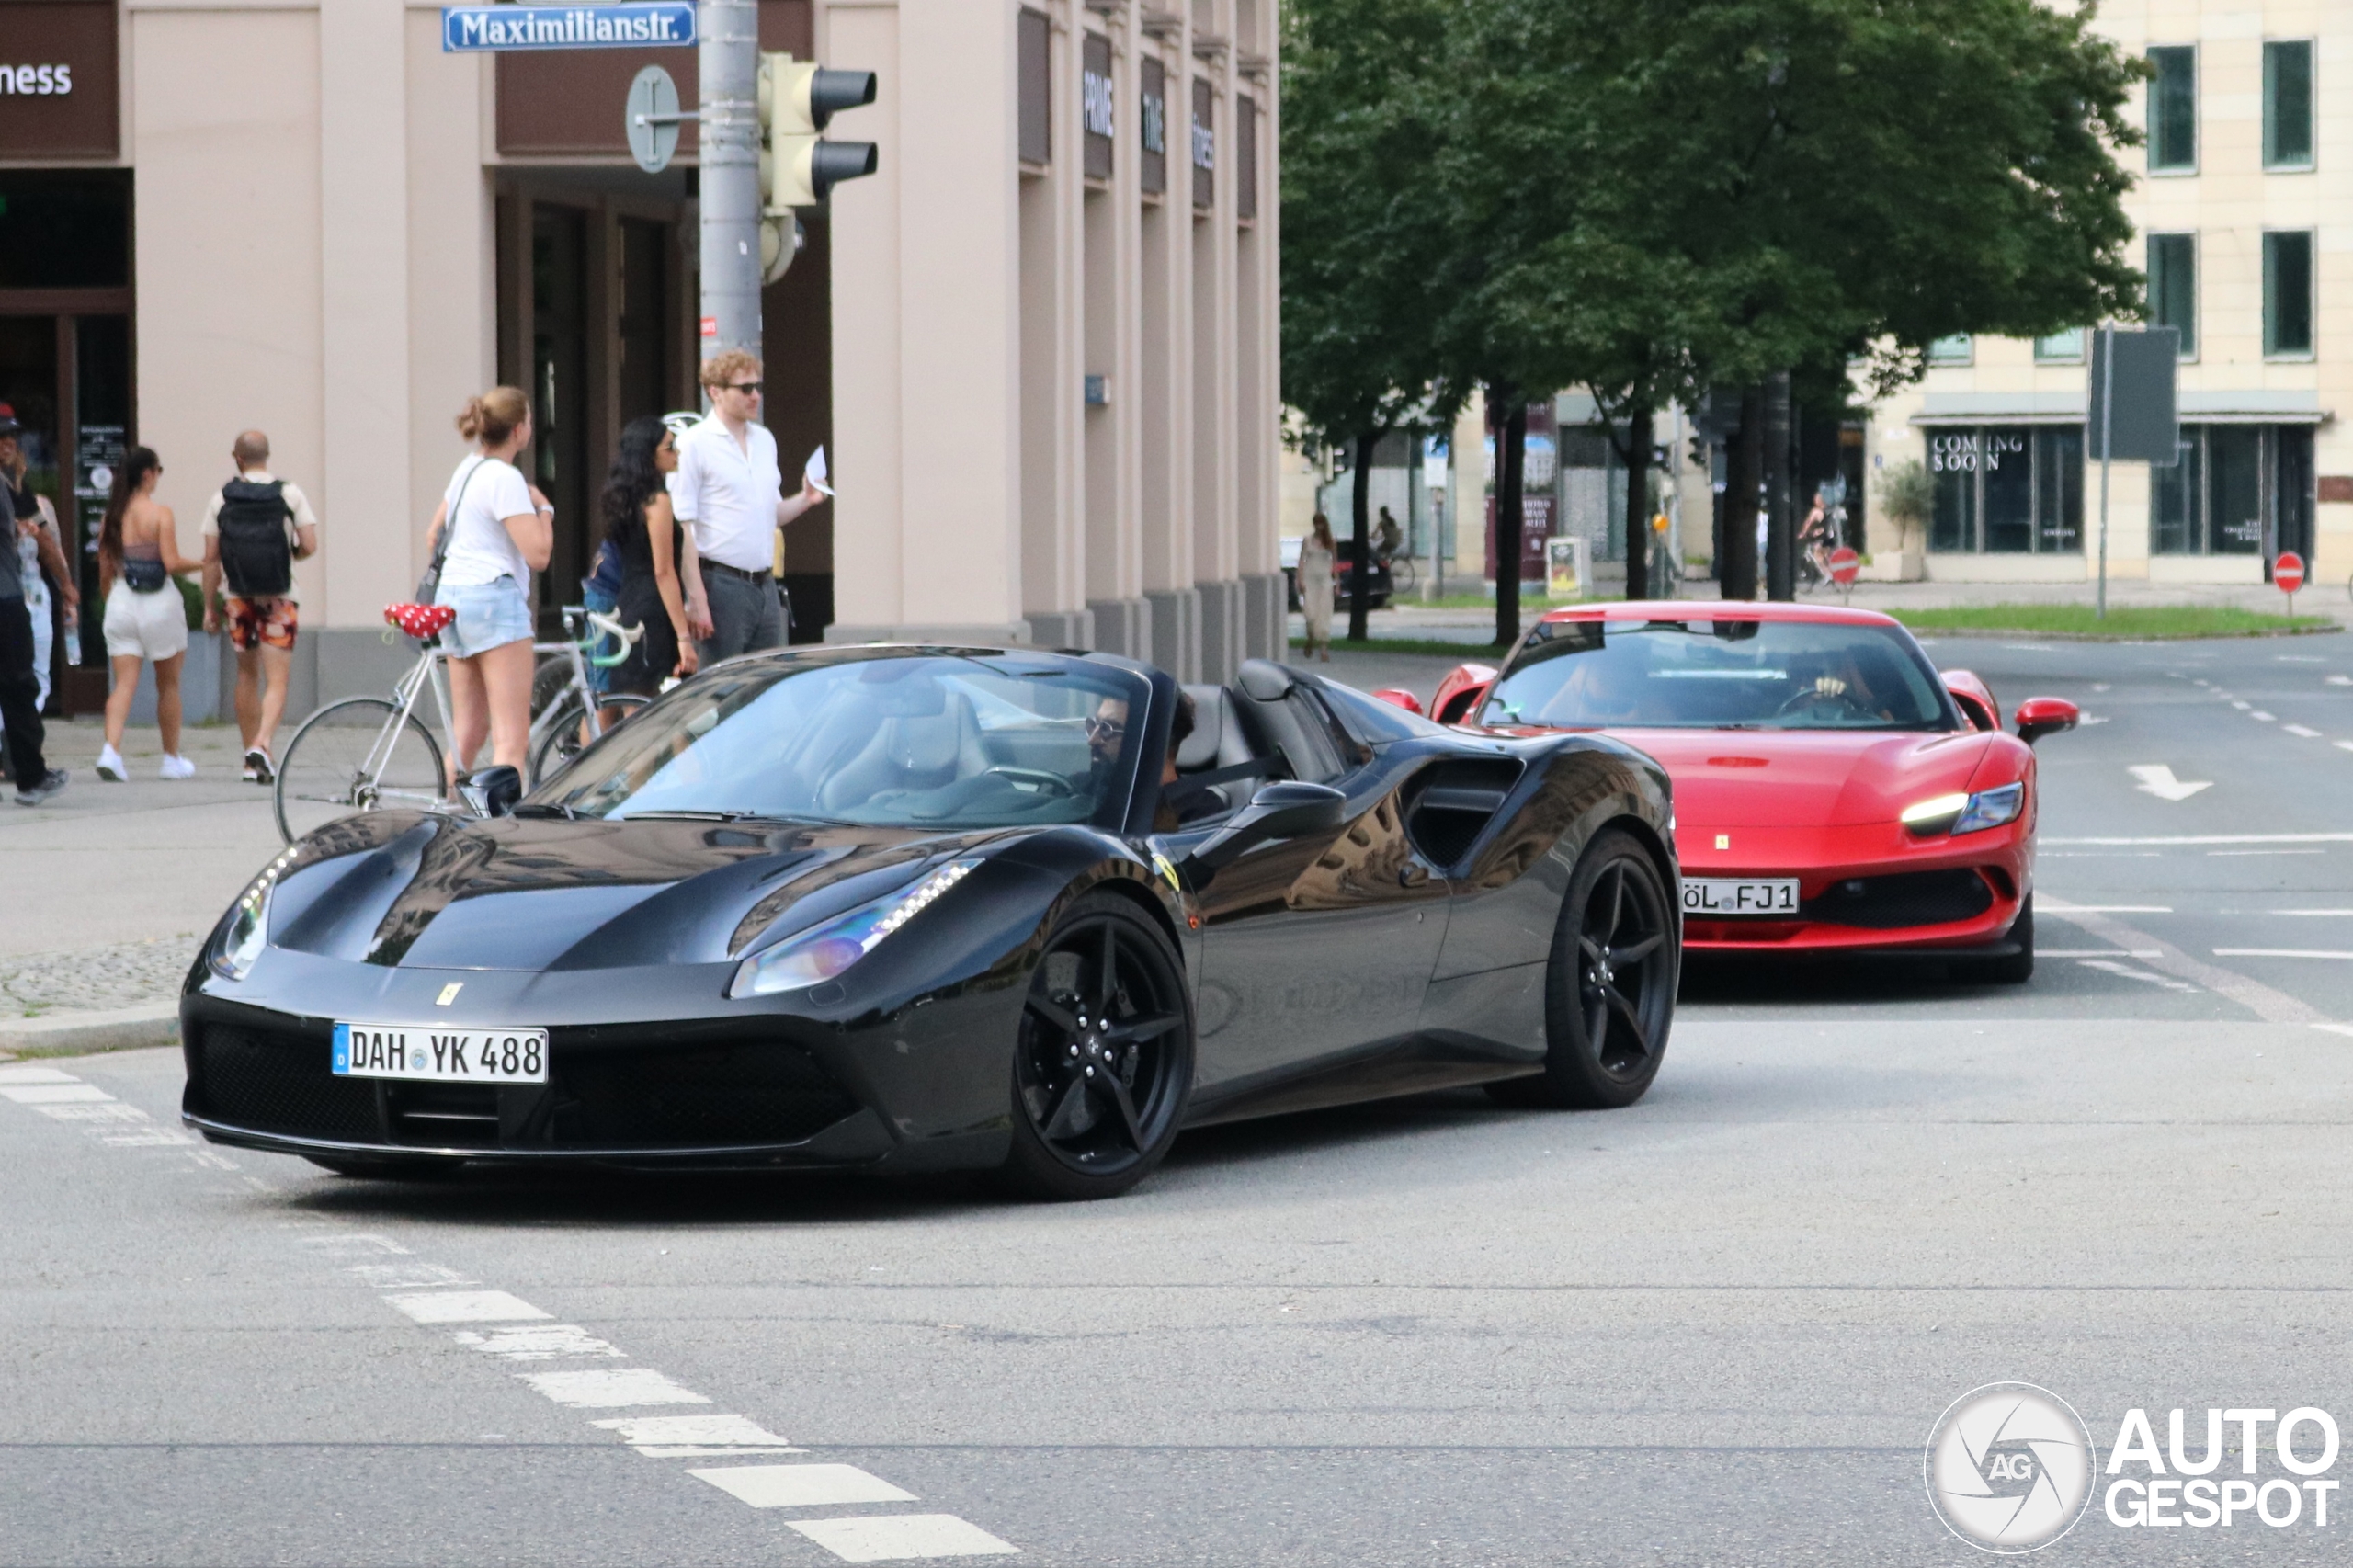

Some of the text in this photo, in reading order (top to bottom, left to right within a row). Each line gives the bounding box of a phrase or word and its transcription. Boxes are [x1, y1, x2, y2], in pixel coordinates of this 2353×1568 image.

[461, 10, 680, 46] Maximilianstr.
[1684, 884, 1719, 909] ÖL
[337, 1053, 346, 1066] D
[352, 1031, 542, 1075] DAH YK 488
